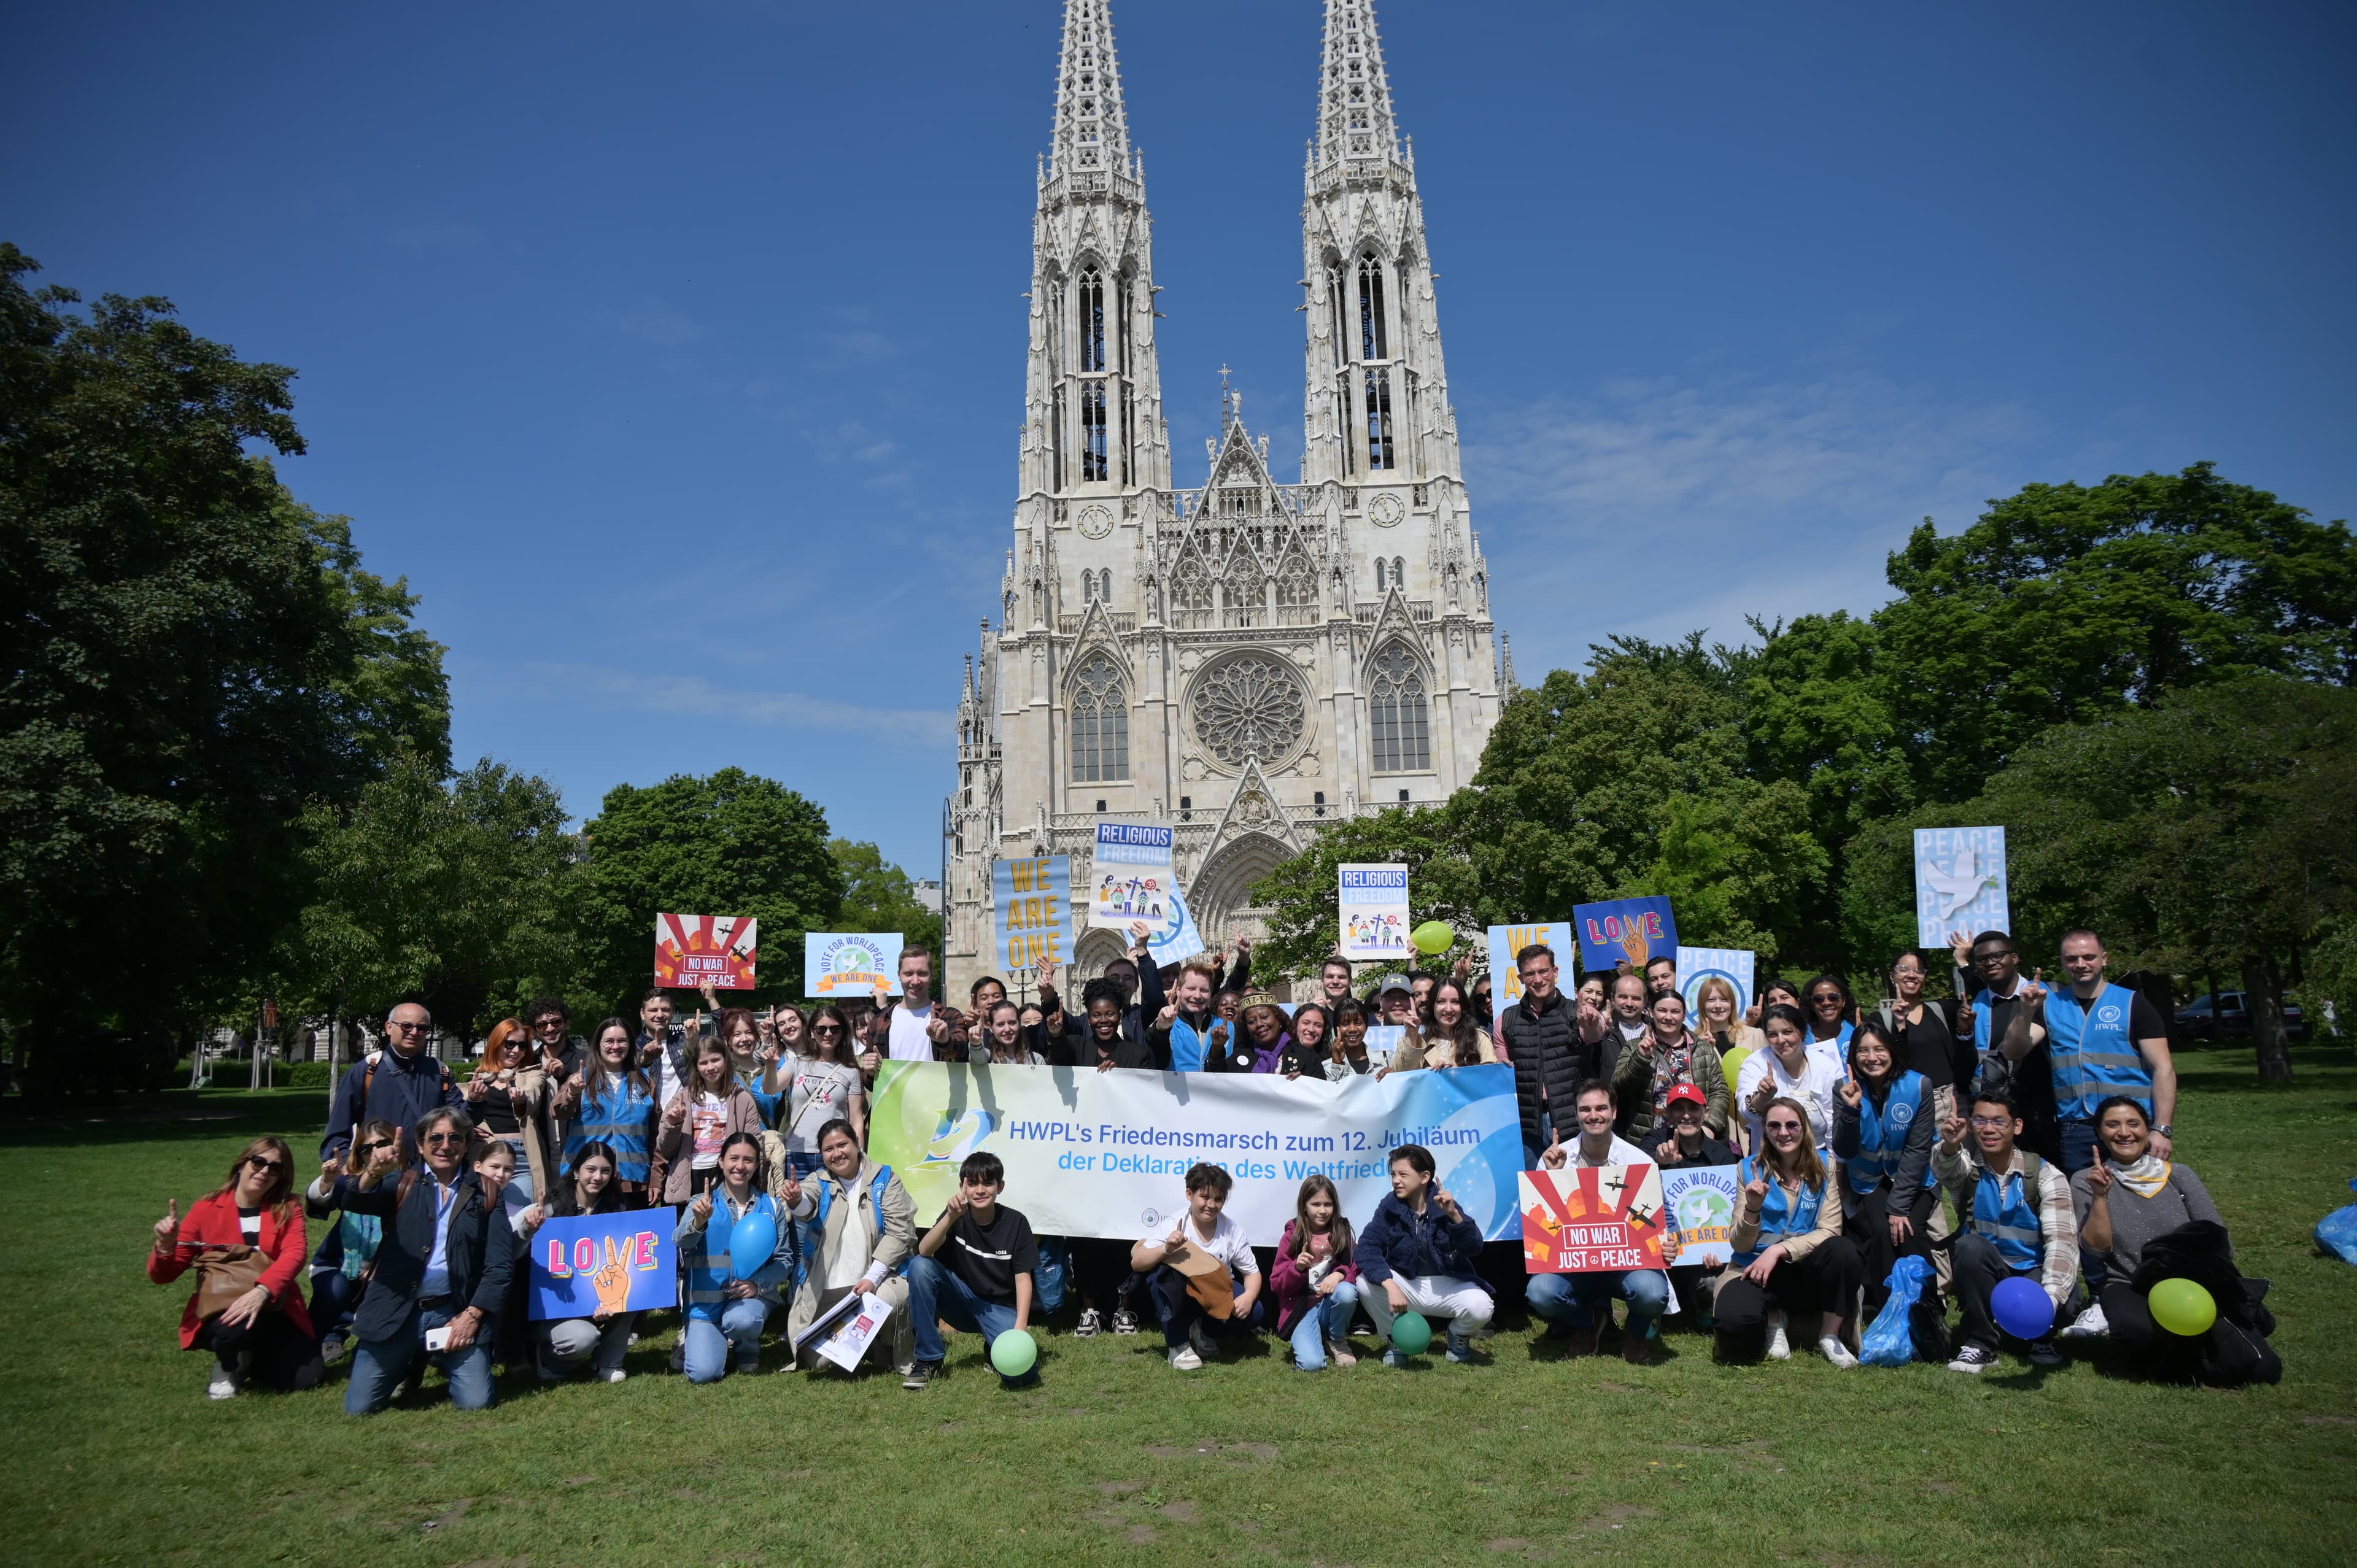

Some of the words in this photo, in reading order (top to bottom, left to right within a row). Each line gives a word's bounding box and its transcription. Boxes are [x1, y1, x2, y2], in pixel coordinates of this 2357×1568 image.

[1101, 824, 1169, 846] RELIGIOUS
[1919, 829, 1999, 856] PEACE
[1104, 845, 1166, 865] FREEDOM
[1011, 859, 1052, 892] WE
[1345, 872, 1403, 887] RELIGIOUS
[1349, 889, 1403, 903] FREEDOM
[1007, 895, 1060, 930] ARE
[1587, 912, 1664, 945] LOVE
[821, 952, 832, 973] VOTE
[829, 938, 845, 953] FOR
[846, 937, 884, 973] WORLDPEACE
[1008, 932, 1062, 968] ONE
[688, 957, 700, 970] NO
[703, 959, 722, 970] WAR
[1681, 949, 1749, 975] PEACE
[678, 974, 699, 986] JUST
[707, 975, 735, 987] PEACE
[845, 973, 859, 982] ARE
[863, 974, 878, 983] ONE
[1010, 1121, 1092, 1143] HWPL's
[1099, 1124, 1277, 1151] Friedensmarsch
[1285, 1136, 1334, 1151] zum
[1341, 1132, 1371, 1151] 12.
[1377, 1125, 1480, 1149] Jubiläum
[1058, 1151, 1096, 1170] der
[1236, 1159, 1276, 1179] des
[1667, 1178, 1689, 1199] FOR
[1571, 1228, 1589, 1245] NO
[1593, 1226, 1620, 1244] WAR
[1678, 1232, 1694, 1244] WE
[1698, 1228, 1717, 1241] ARE
[548, 1230, 659, 1278] LOVE
[1558, 1251, 1588, 1269] JUST
[1601, 1249, 1642, 1267] PEACE
